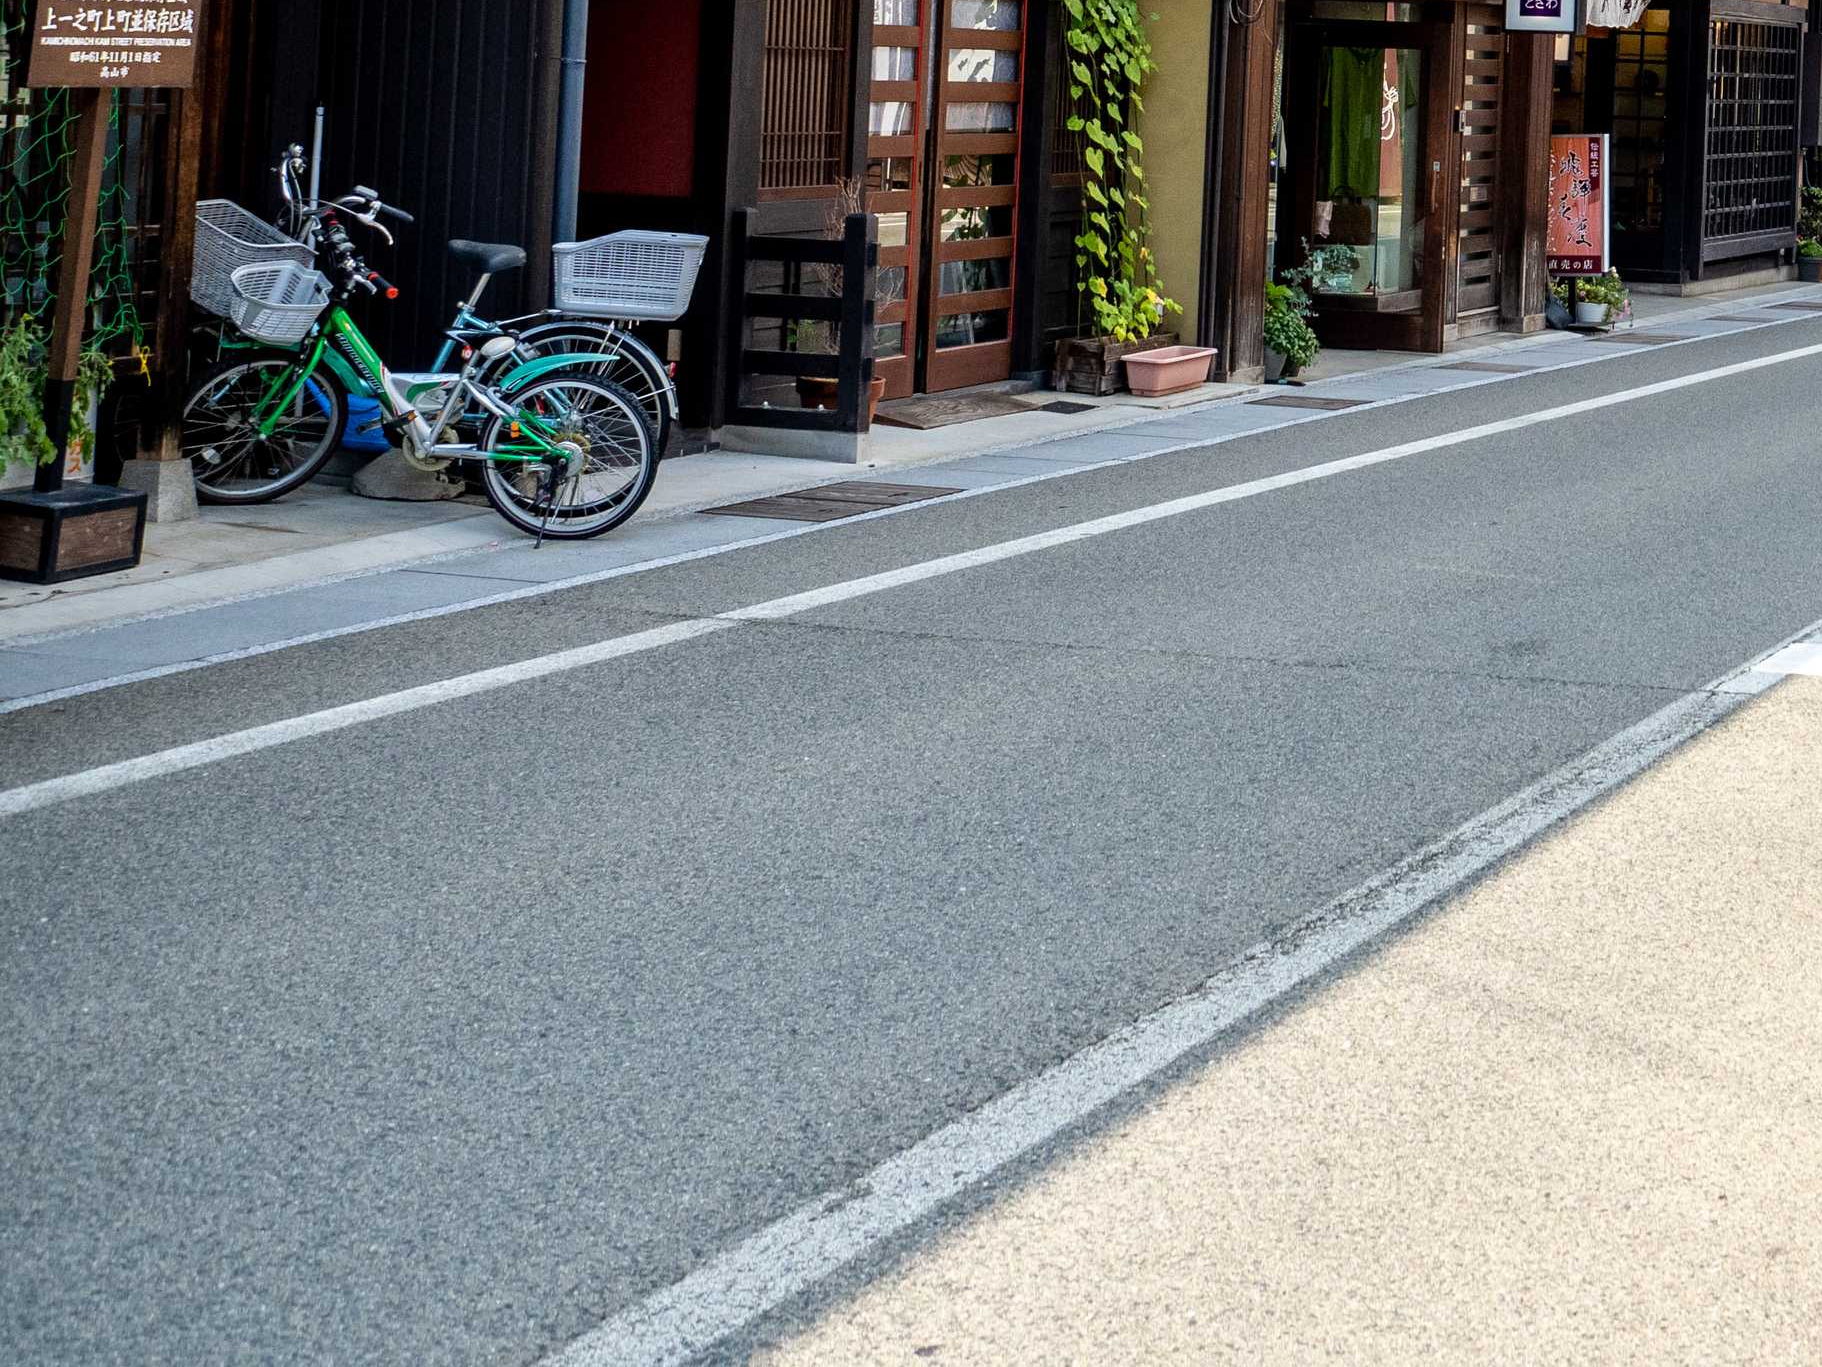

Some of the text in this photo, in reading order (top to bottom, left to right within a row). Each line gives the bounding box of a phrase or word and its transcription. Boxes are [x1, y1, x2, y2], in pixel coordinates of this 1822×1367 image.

[41, 7, 194, 34] 上一之町上町並保存区域
[100, 66, 130, 78] 高山市
[1548, 259, 1593, 271] 直売の店
